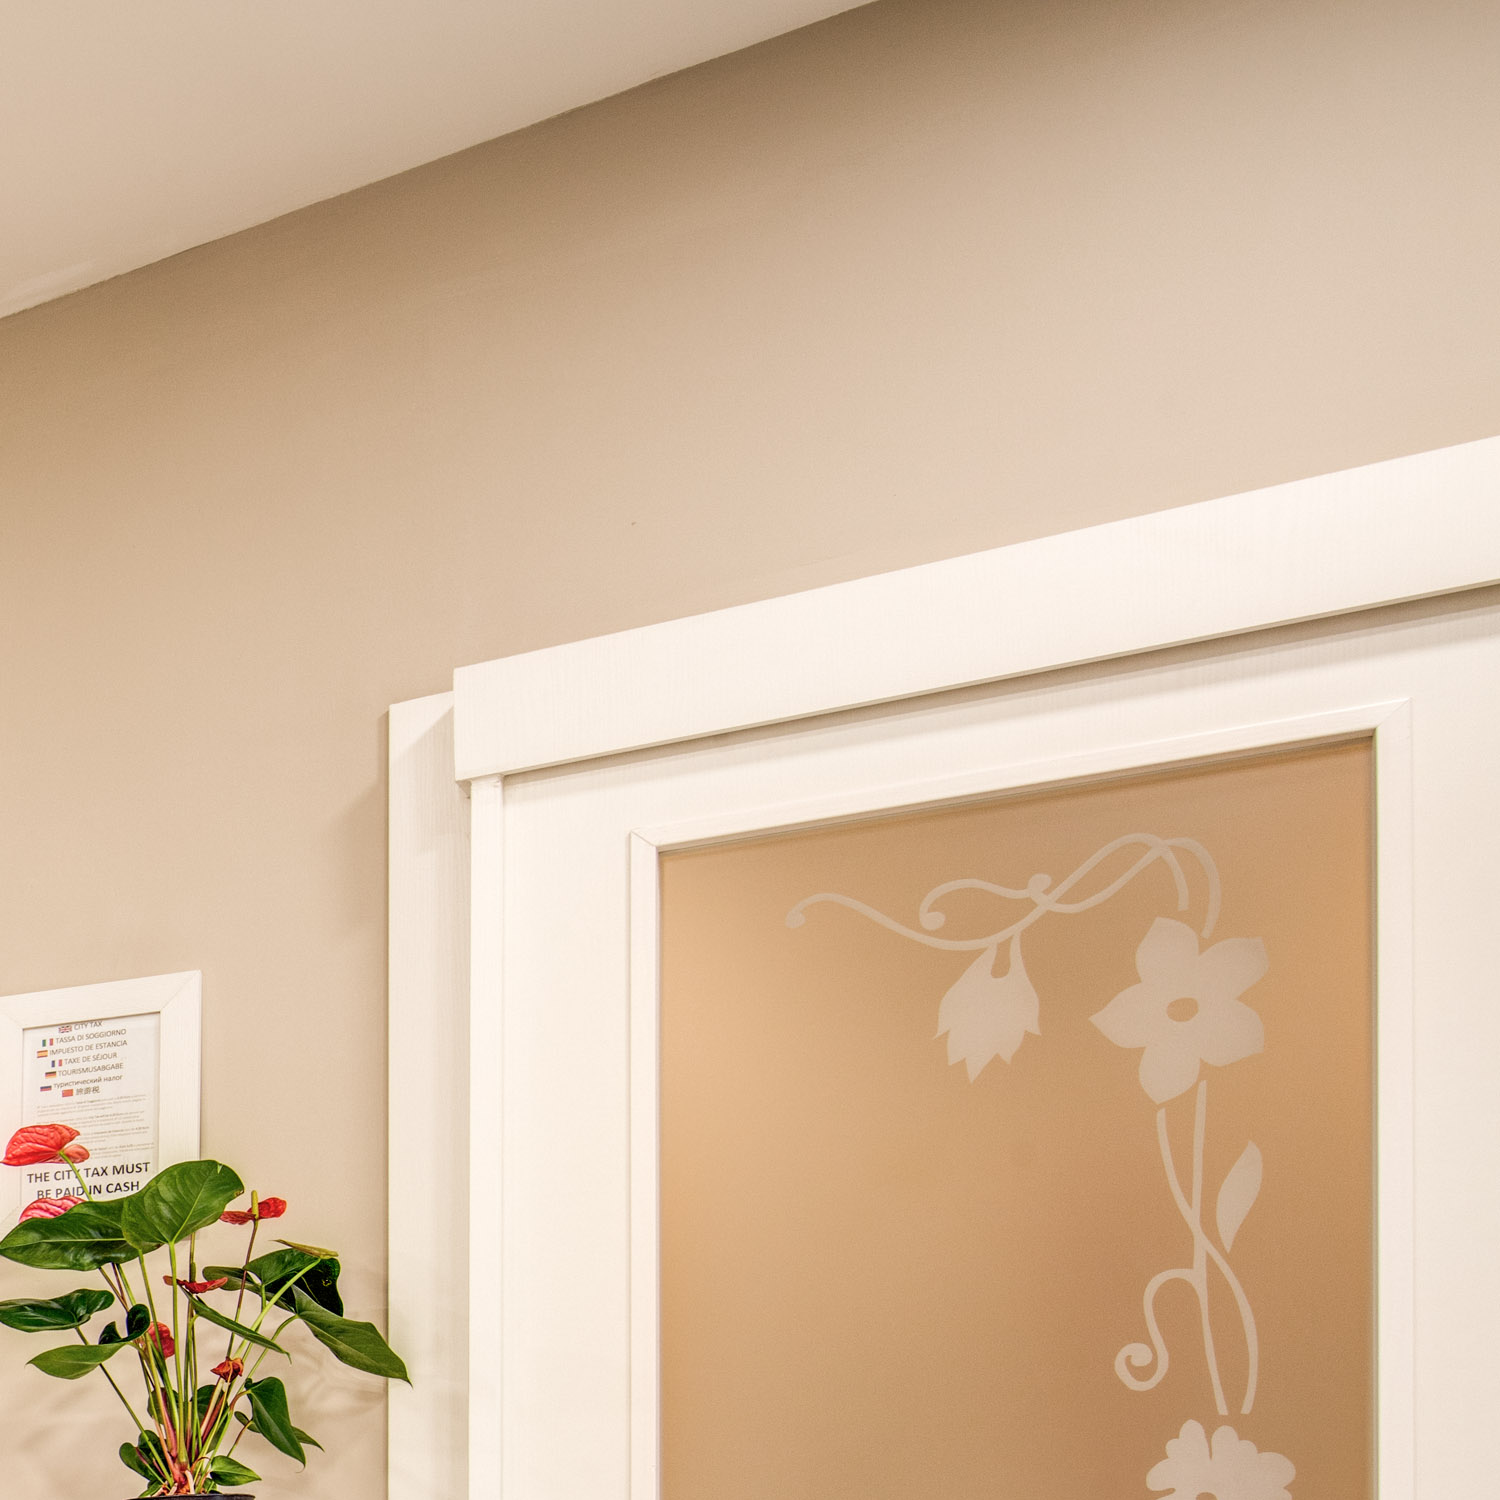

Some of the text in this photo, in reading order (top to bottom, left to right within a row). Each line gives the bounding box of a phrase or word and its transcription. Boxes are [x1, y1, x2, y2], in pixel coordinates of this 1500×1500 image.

[74, 1022, 88, 1030] CITY
[56, 1036, 76, 1044] TASSA
[86, 1028, 126, 1040] SOGGIORNO
[50, 1045, 83, 1056] IMPUESTO
[96, 1040, 128, 1050] ESTANCIA
[92, 1052, 118, 1061] SÉJOUR
[58, 1062, 124, 1076] TOURISMUSABGABE
[54, 1076, 102, 1088] туристический
[27, 1162, 150, 1183] THE CITY TAX MUST
[37, 1181, 140, 1199] BE PAID IN CASH
